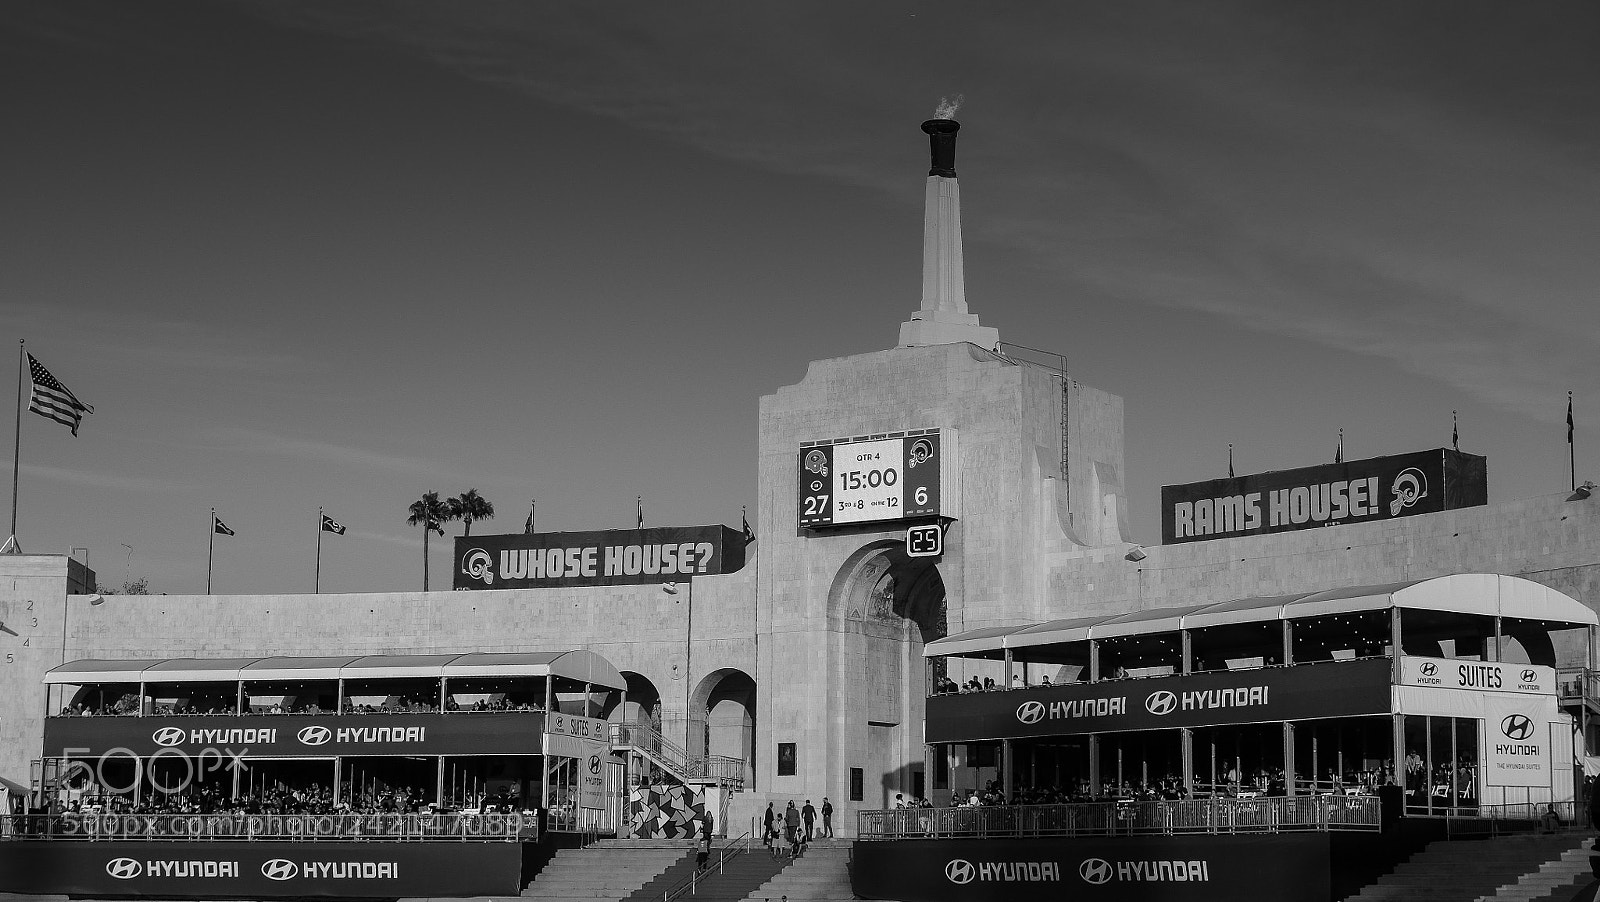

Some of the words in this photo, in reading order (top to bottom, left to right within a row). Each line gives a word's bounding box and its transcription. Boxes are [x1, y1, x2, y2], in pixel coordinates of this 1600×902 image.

[856, 454, 873, 462] QTR
[840, 467, 898, 491] 15:00
[804, 495, 829, 516] 27
[857, 499, 864, 510] 8
[886, 496, 899, 508] 12
[914, 486, 929, 506] 6
[1175, 492, 1262, 538] RAMS
[1269, 477, 1379, 527] HOUSE!
[912, 531, 936, 552] 25
[499, 547, 598, 580] WHOSE
[604, 542, 714, 576] HOUSE?
[26, 600, 34, 611] 2
[31, 617, 38, 628] 3
[22, 637, 30, 647] 4
[6, 653, 14, 664] 5
[1458, 664, 1502, 688] SUITES
[1049, 696, 1126, 720] HYUNDAI
[1181, 685, 1269, 711] HYUNDAI
[190, 728, 277, 744] HYUNDAI
[336, 726, 425, 743] HYUNDAI
[1495, 744, 1540, 756] HYUNDAI
[146, 860, 239, 878] HYUNDAI
[303, 861, 399, 879] HYUNDAI
[978, 861, 1060, 882] HYUNDAI
[1117, 860, 1209, 882] HYUNDAI
